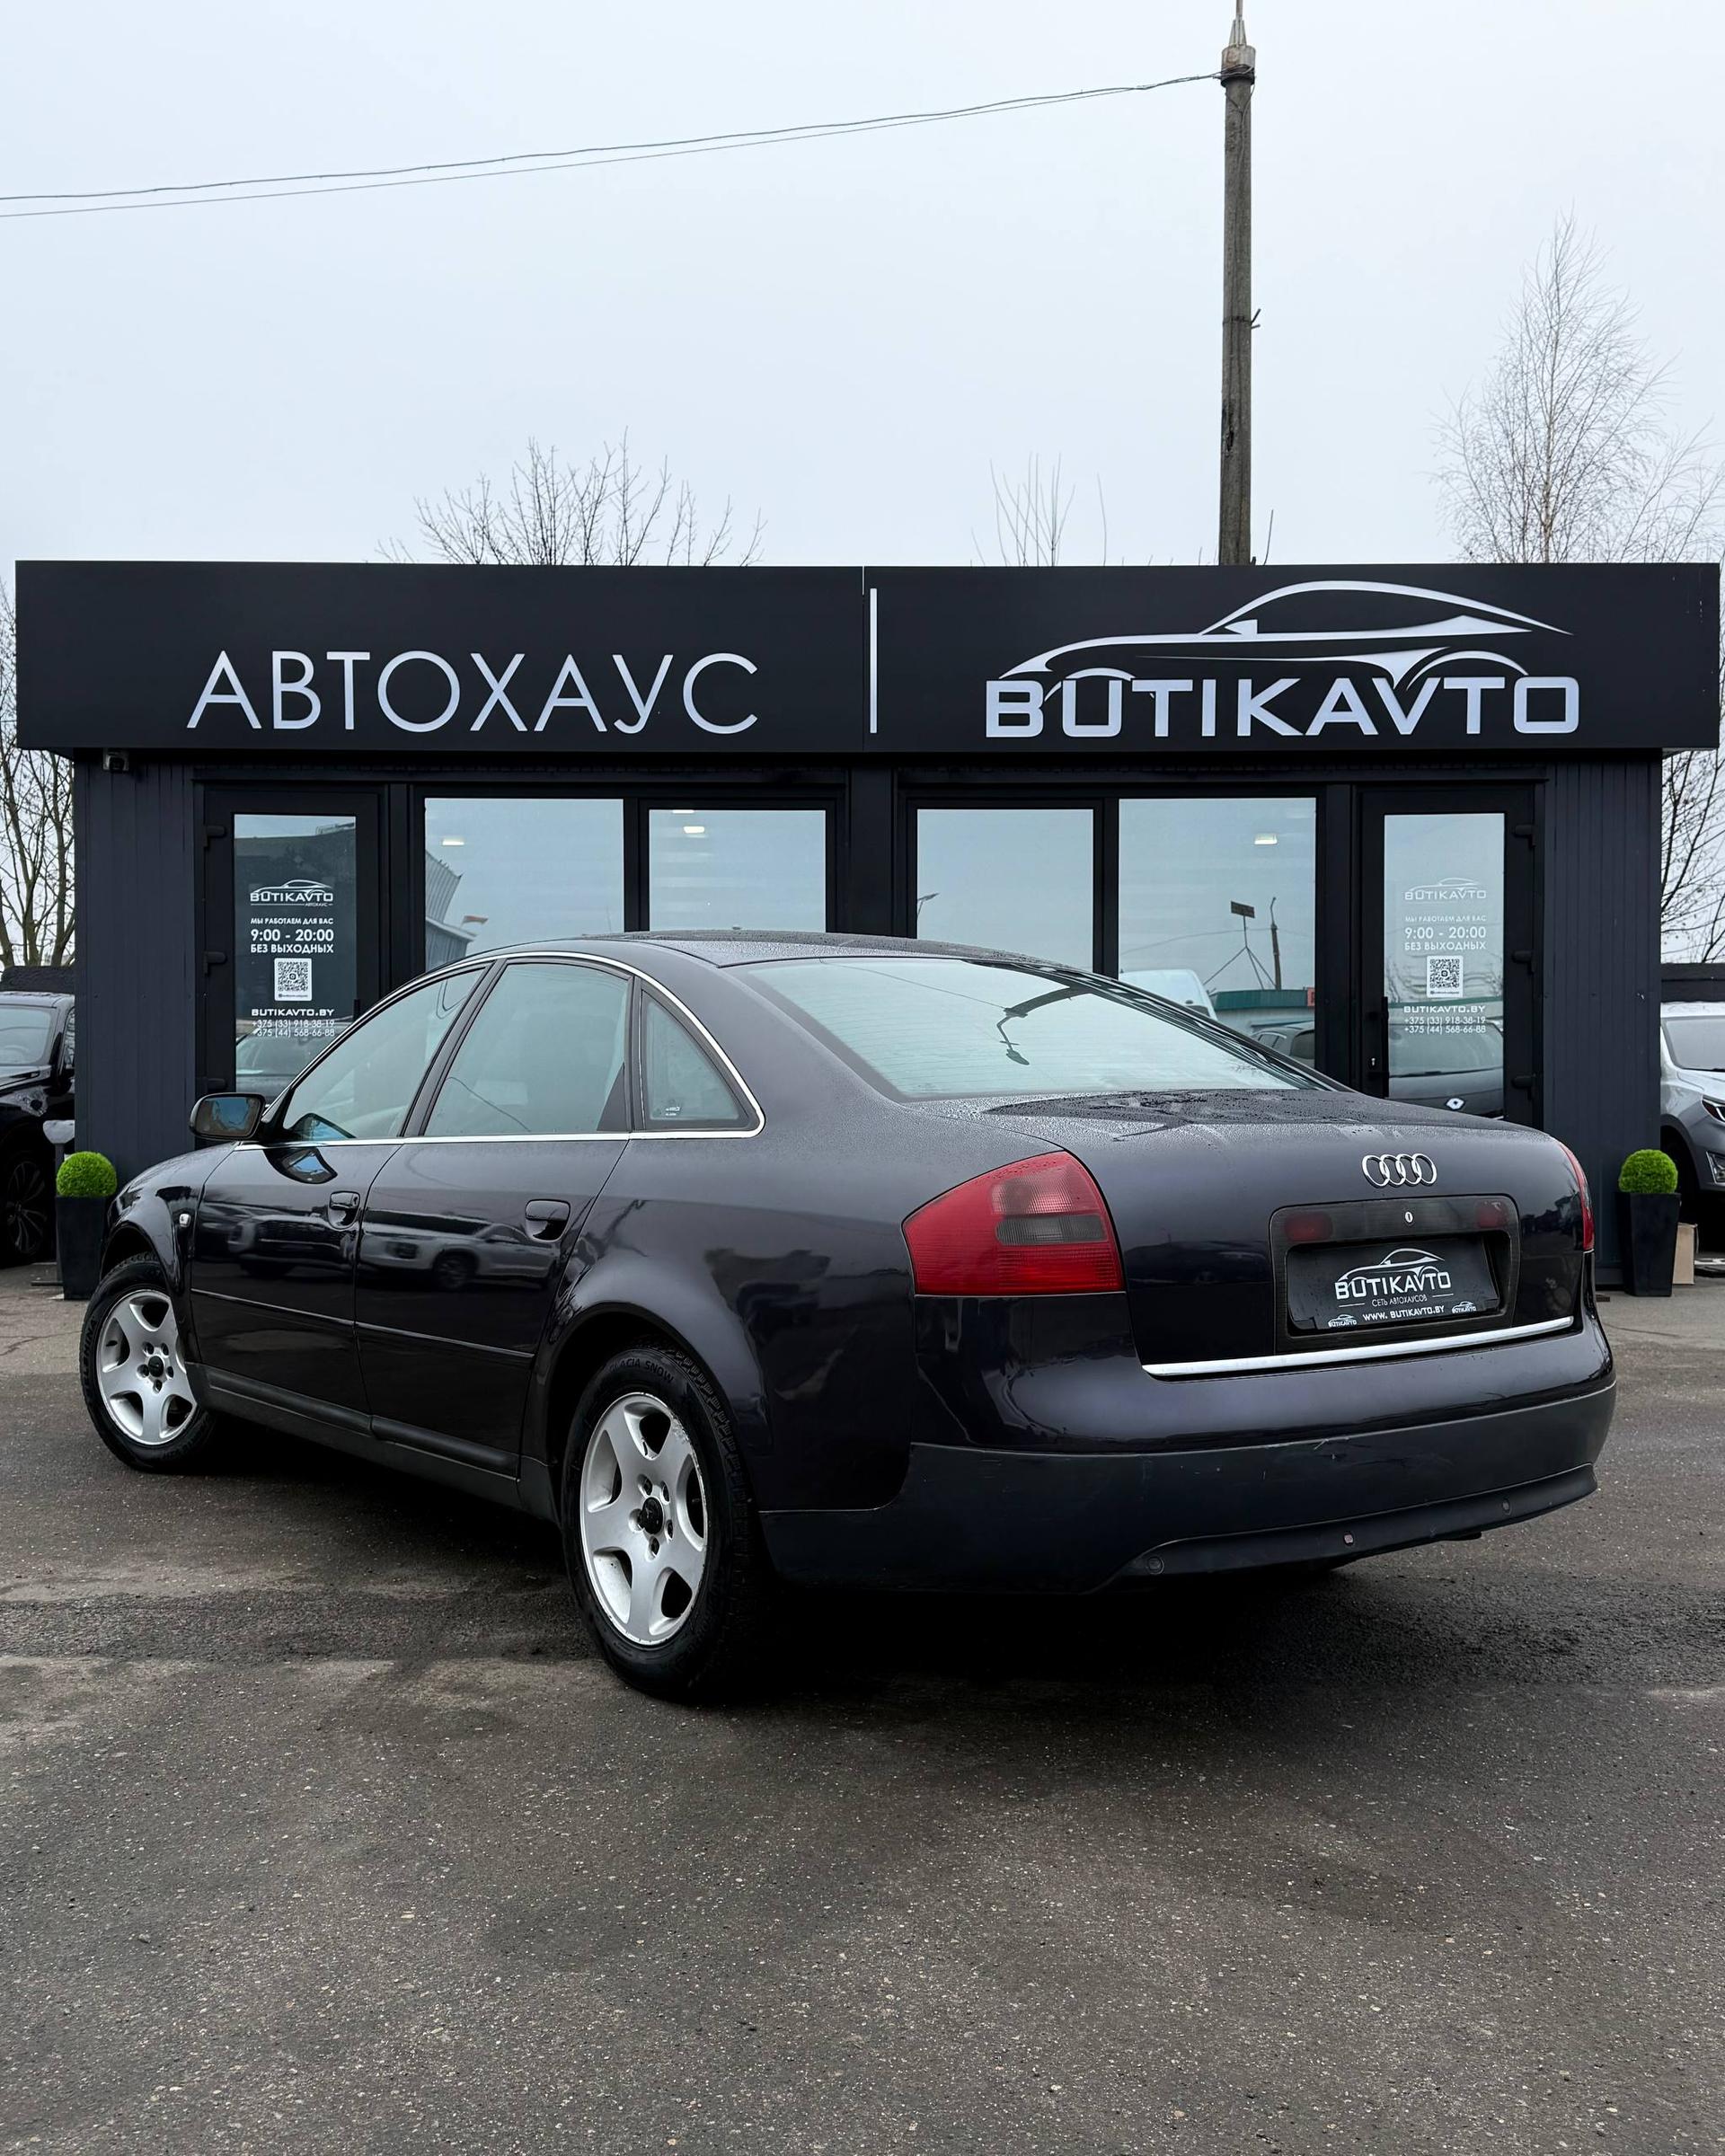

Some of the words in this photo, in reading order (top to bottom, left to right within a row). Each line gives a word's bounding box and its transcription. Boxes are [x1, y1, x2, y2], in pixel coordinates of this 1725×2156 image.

[186, 649, 759, 734] АВТОХАУС
[986, 676, 1580, 738] BUTIKAVTO
[250, 892, 333, 902] BUTIKAVTO
[1404, 890, 1487, 900] BUTIKAVTO
[251, 928, 281, 941] 9:00
[295, 928, 334, 941] 20:00
[1404, 926, 1434, 939] 9:00
[1448, 925, 1486, 939] 20:00
[250, 943, 269, 953] БЕЗ
[270, 943, 334, 954] ВЫХОДНЫХ
[1404, 941, 1421, 950] БЕЗ
[1424, 941, 1486, 951] ВЫХОДНЫХ
[251, 1008, 335, 1016] BUTIKAVTO.BY
[1403, 1005, 1486, 1013] BUTIKAVTO.BY
[252, 1020, 272, 1028] +375
[275, 1019, 291, 1029] (33)
[293, 1020, 335, 1028] 918-38-19
[1404, 1016, 1425, 1024] +375
[1427, 1016, 1443, 1026] (33)
[1445, 1016, 1486, 1024] 918-38-19
[275, 1028, 291, 1038] (44)
[293, 1028, 335, 1037] 568-66-88
[1404, 1025, 1425, 1034] +375
[1427, 1025, 1443, 1035] (44)
[1445, 1025, 1487, 1034] 568-66-88
[1334, 1271, 1452, 1300] BUTIKAVTO
[1371, 1298, 1388, 1307] СЕТЬ
[1389, 1294, 1428, 1305] АВТОХАУСОВ
[1362, 1311, 1388, 1321] WWW.
[1389, 1305, 1445, 1319] BUTIKAVTO.BY
